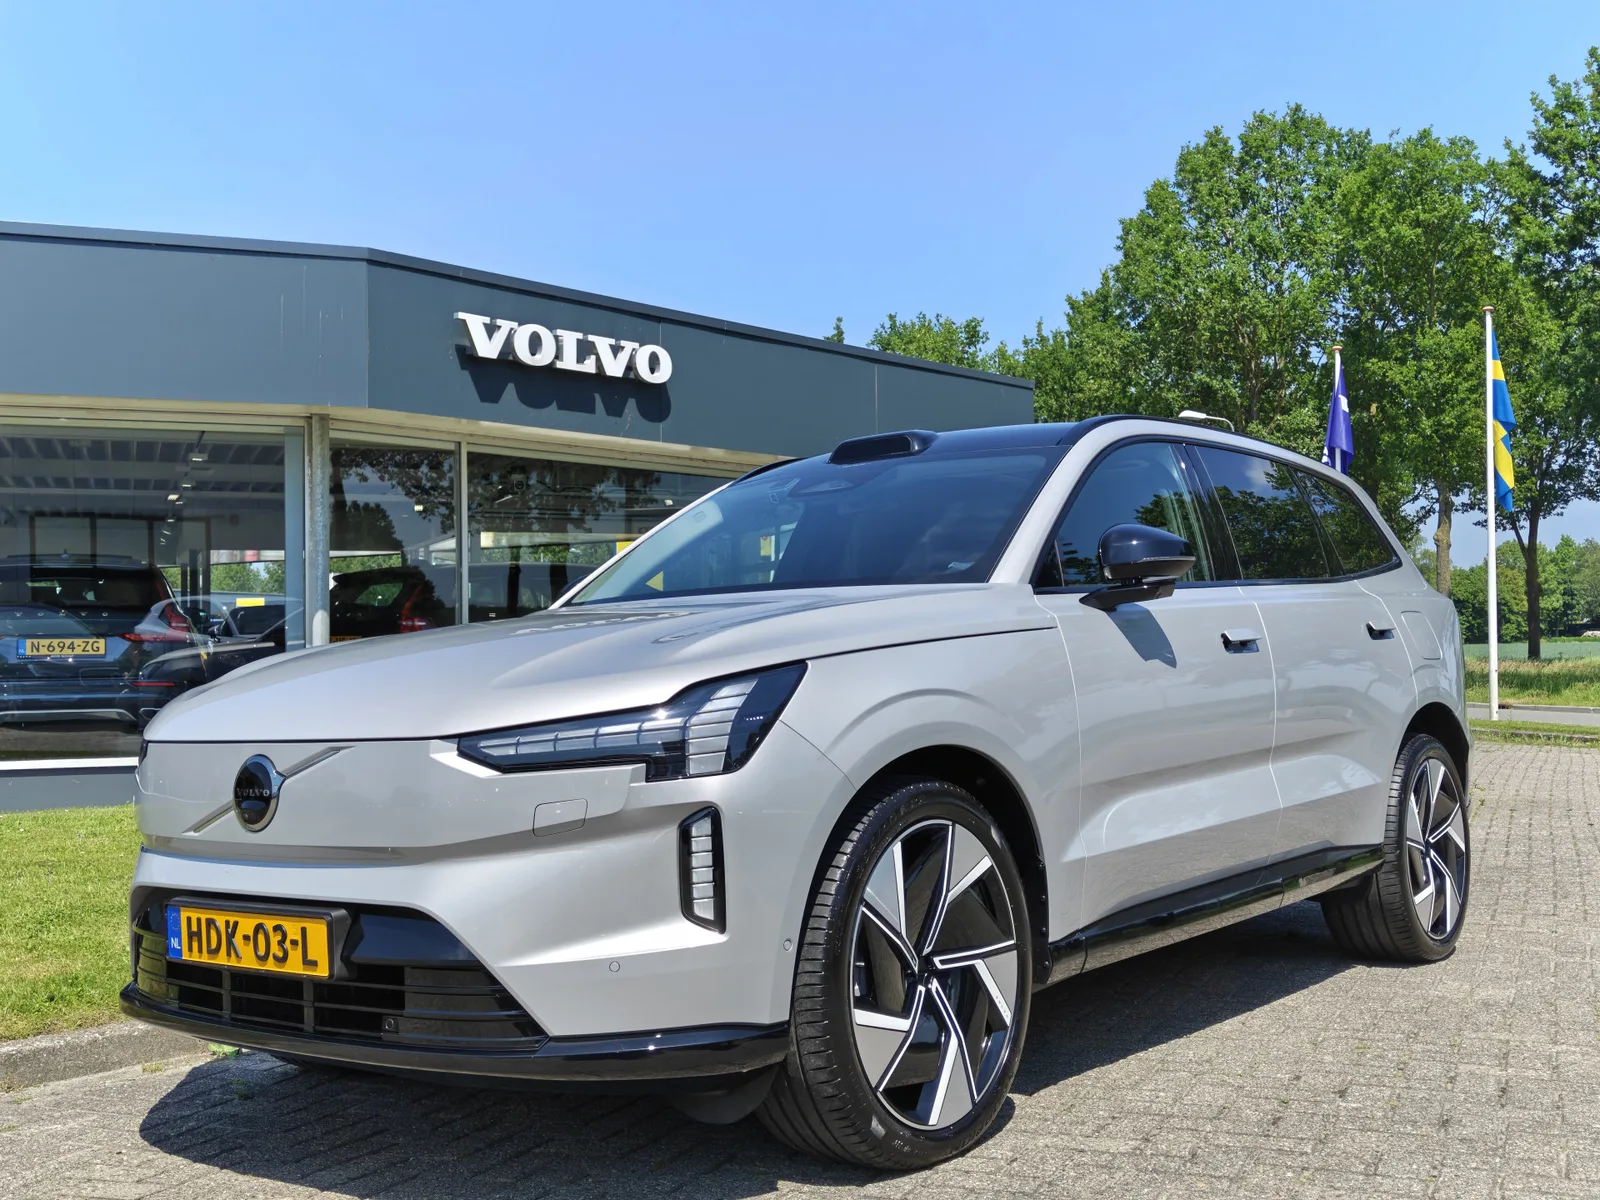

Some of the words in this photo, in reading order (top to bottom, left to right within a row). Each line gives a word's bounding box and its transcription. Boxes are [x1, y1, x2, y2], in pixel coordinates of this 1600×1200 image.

[454, 311, 673, 384] VOLVO
[30, 640, 101, 653] N-694-ZG
[236, 787, 270, 797] VOLVO
[170, 937, 182, 950] NL
[186, 915, 319, 968] HDK-03-L
